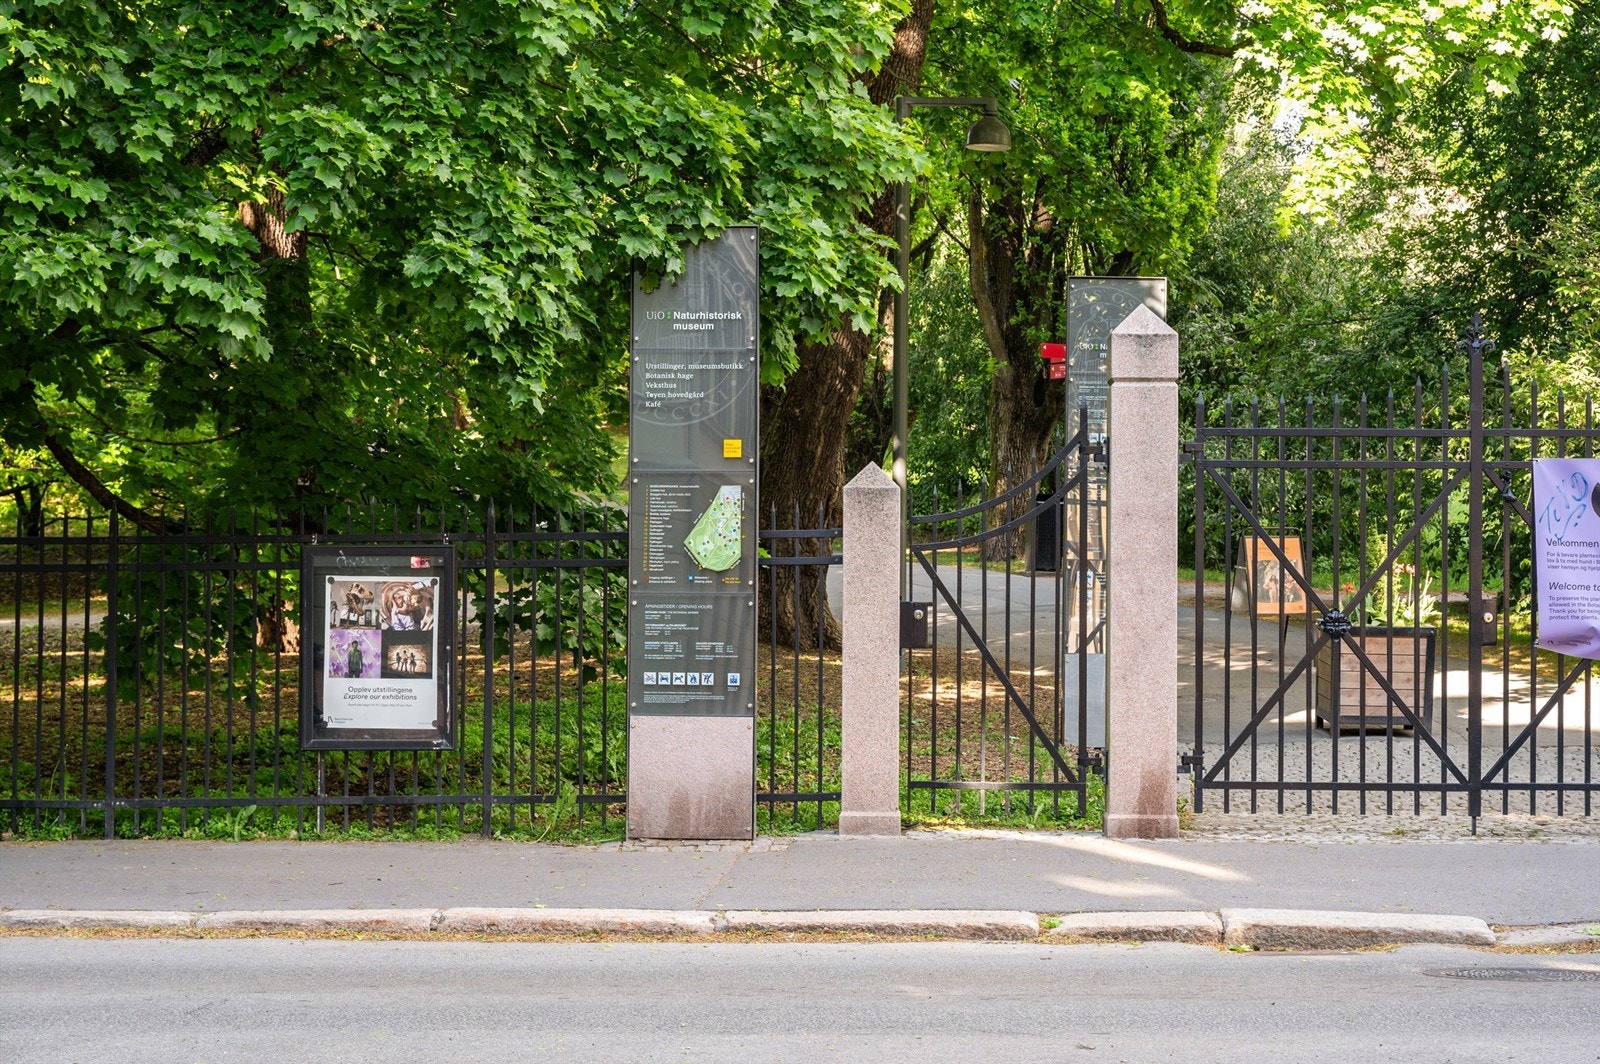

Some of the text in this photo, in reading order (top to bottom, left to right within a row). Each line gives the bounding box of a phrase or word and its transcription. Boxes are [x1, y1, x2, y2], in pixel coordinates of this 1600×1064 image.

[673, 311, 742, 320] Naturhistorisk
[673, 323, 714, 331] museum
[645, 363, 687, 371] Utstillinger,
[677, 373, 694, 381] hage
[645, 391, 705, 400] Tøyen hovedgård
[645, 400, 662, 408] Kafé
[1546, 538, 1600, 548] Velkommen
[1548, 582, 1591, 591] Welcome
[372, 686, 413, 694] utstillingene
